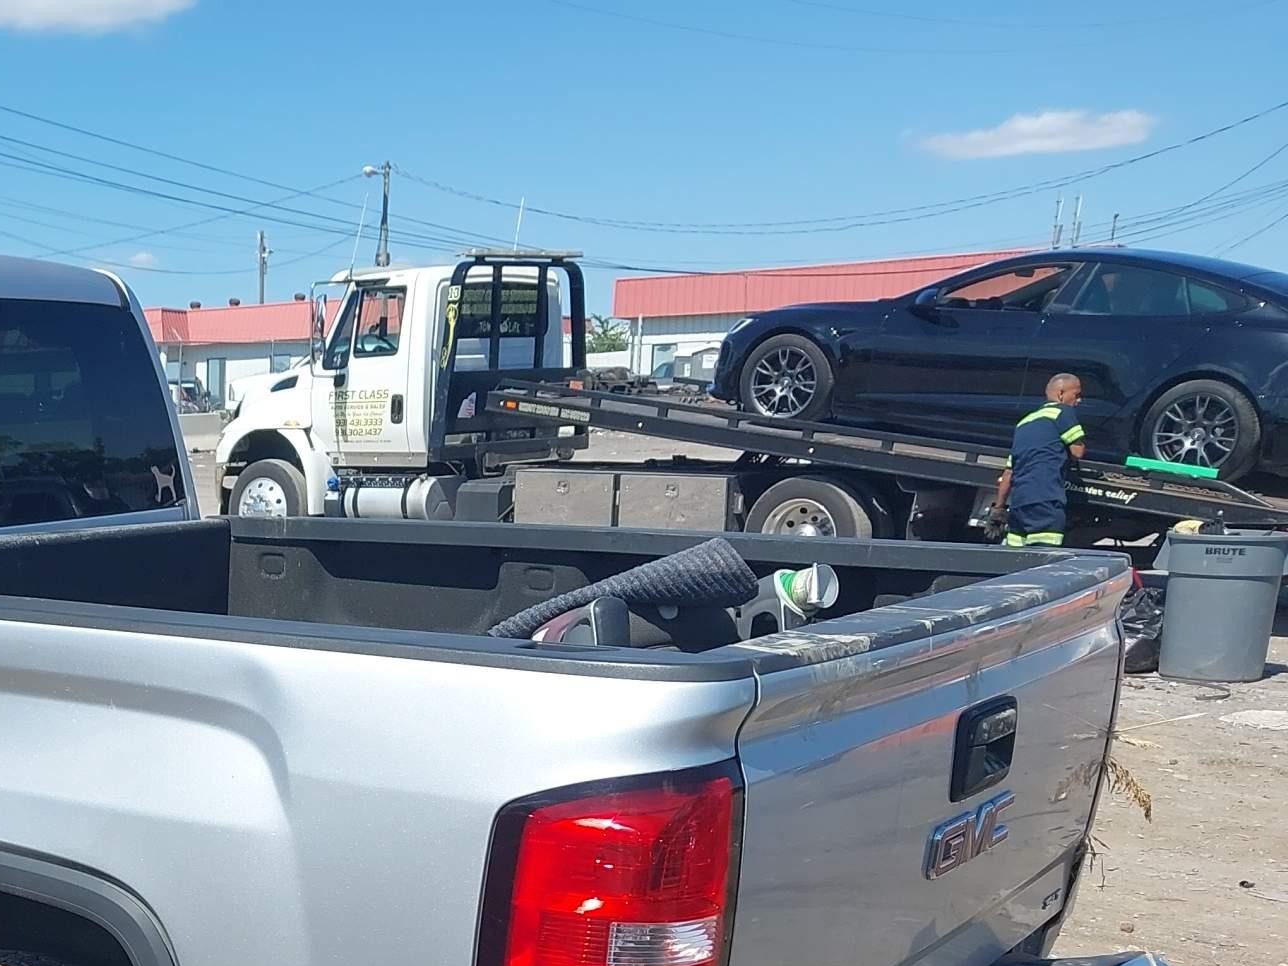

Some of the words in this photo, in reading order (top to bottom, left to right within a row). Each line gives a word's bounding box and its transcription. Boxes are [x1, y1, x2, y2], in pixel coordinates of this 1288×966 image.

[328, 390, 356, 401] FIRST
[358, 389, 389, 400] CLASS
[1064, 481, 1104, 496] Disaster
[1105, 489, 1138, 505] relief
[1205, 547, 1247, 556] BRUTE
[922, 790, 1016, 880] GMC
